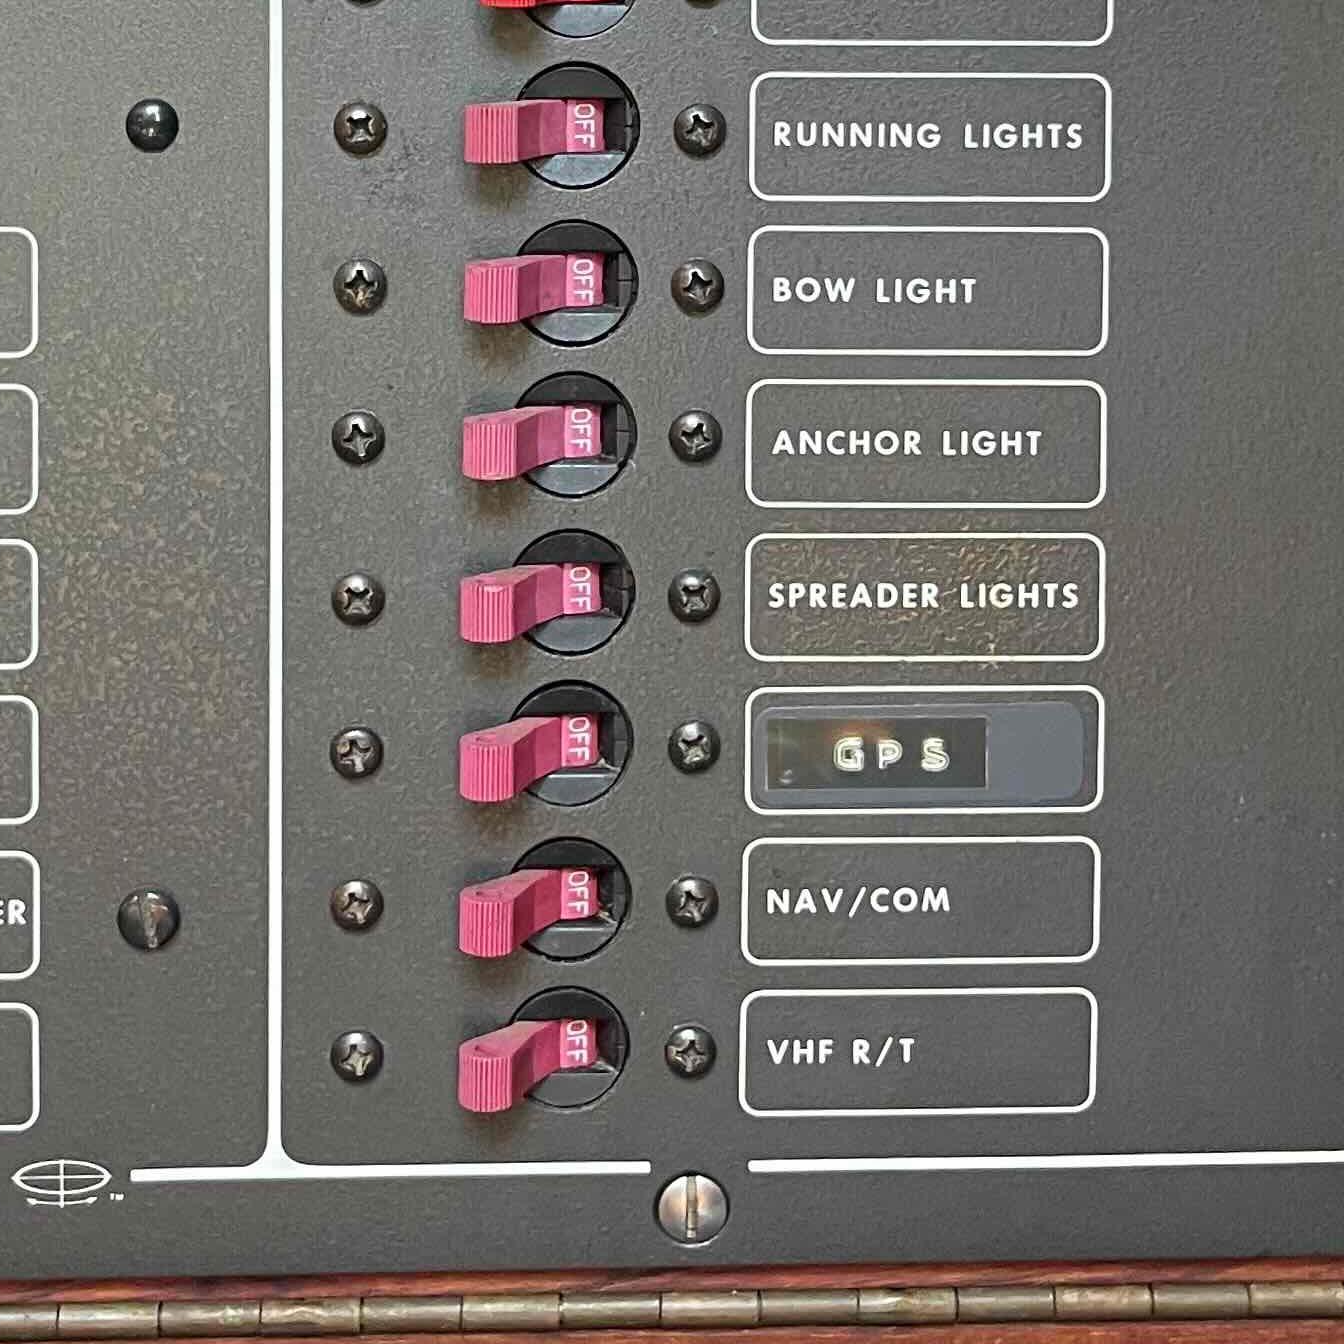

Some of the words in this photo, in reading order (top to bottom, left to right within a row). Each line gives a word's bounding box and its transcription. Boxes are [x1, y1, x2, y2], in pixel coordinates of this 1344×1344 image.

[574, 103, 595, 149] OFF
[773, 121, 941, 148] RUNNING
[963, 122, 1083, 149] LIGHTS
[572, 257, 594, 303] OFF
[772, 277, 855, 303] BOW
[876, 278, 977, 304] LIGHT
[571, 407, 592, 452] OFF
[771, 430, 922, 456] ANCHOR
[943, 430, 1042, 456] LIGHT
[571, 565, 591, 610] OFF
[768, 583, 938, 610] SPREADER
[960, 584, 1079, 610] LIGHTS
[570, 716, 591, 761] OFF
[832, 736, 952, 771] GPS
[568, 870, 589, 916] OFF
[767, 887, 950, 917] NAV/COM
[767, 1039, 834, 1064] VHF
[853, 1037, 915, 1065] R/T
